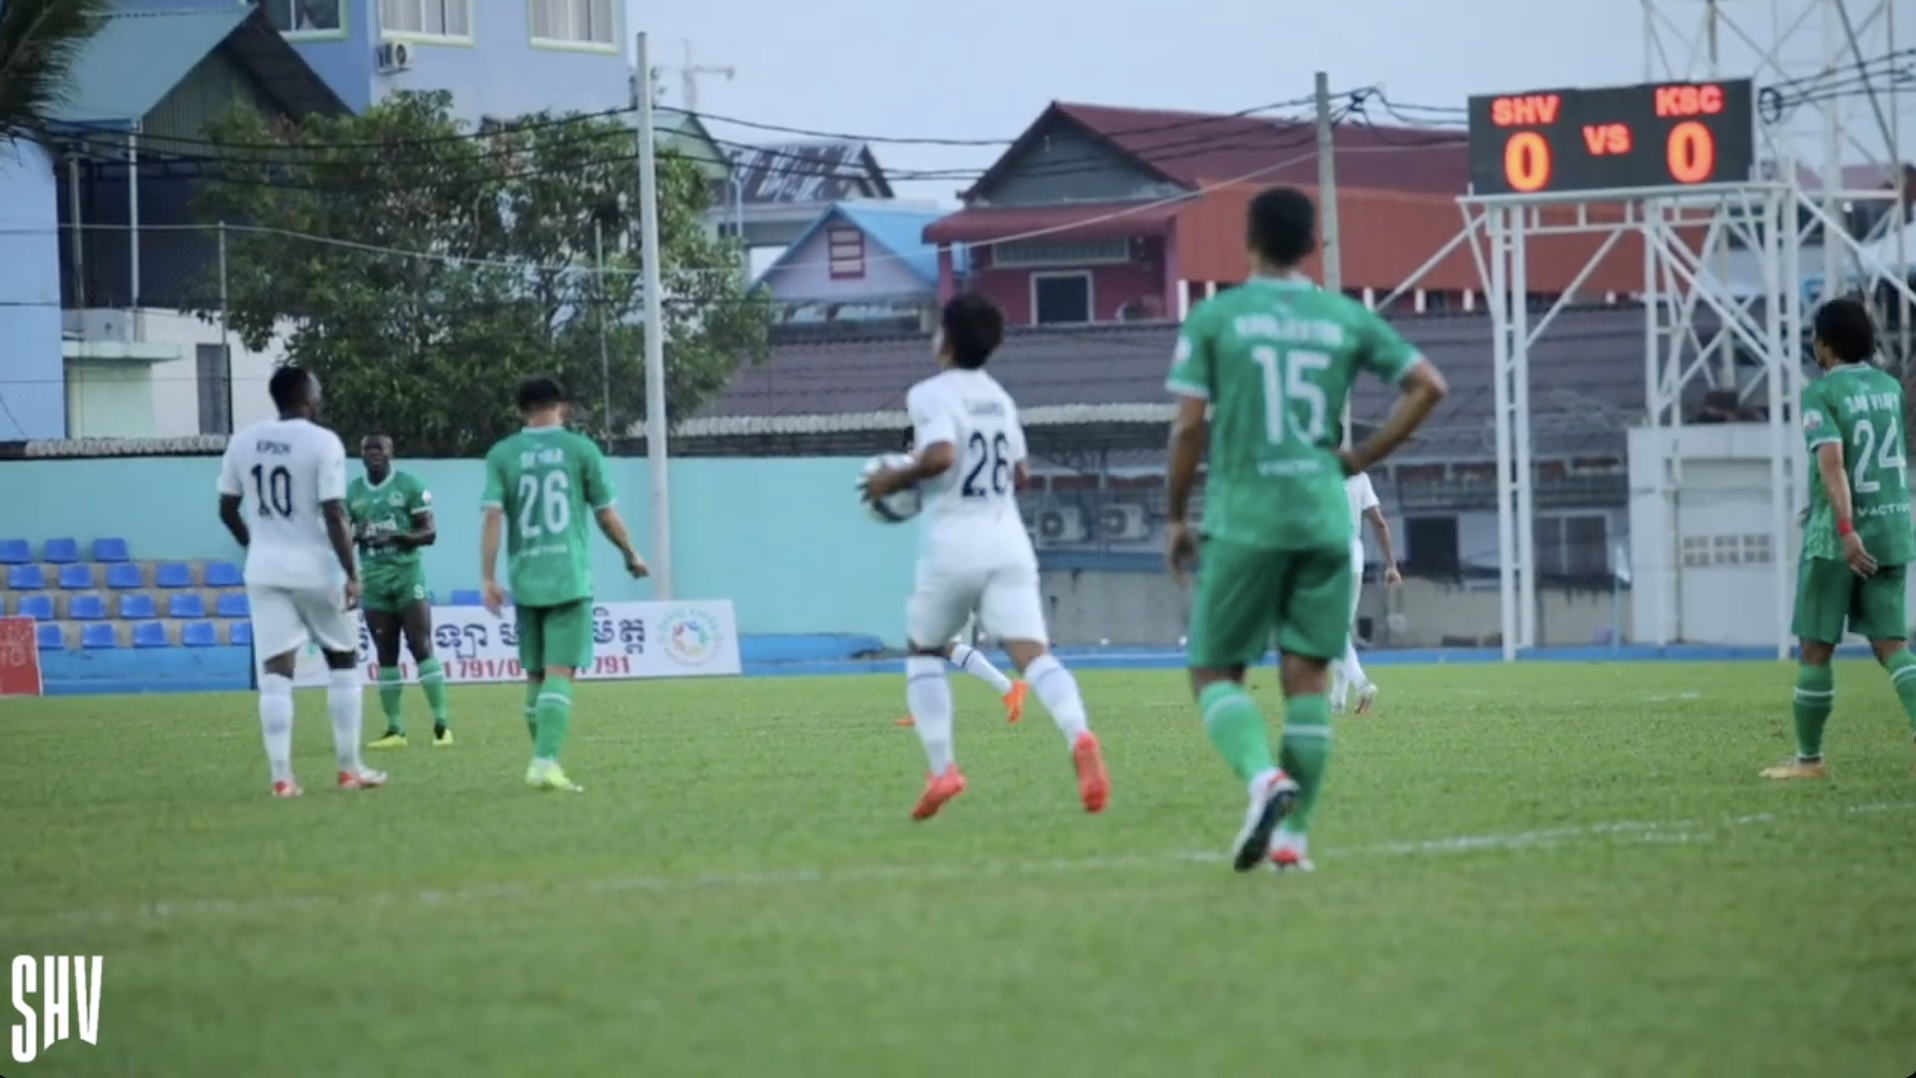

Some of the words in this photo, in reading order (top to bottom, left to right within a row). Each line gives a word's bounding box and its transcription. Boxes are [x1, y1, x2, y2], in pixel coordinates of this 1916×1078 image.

[1491, 95, 1559, 126] SHV
[1655, 84, 1723, 117] KSC
[1503, 130, 1550, 192] 0
[1665, 120, 1714, 184] 0
[1251, 345, 1331, 446] 15
[962, 428, 1010, 498] 26
[1853, 415, 1907, 494] 24
[250, 463, 293, 518] 10
[518, 469, 571, 538] 26
